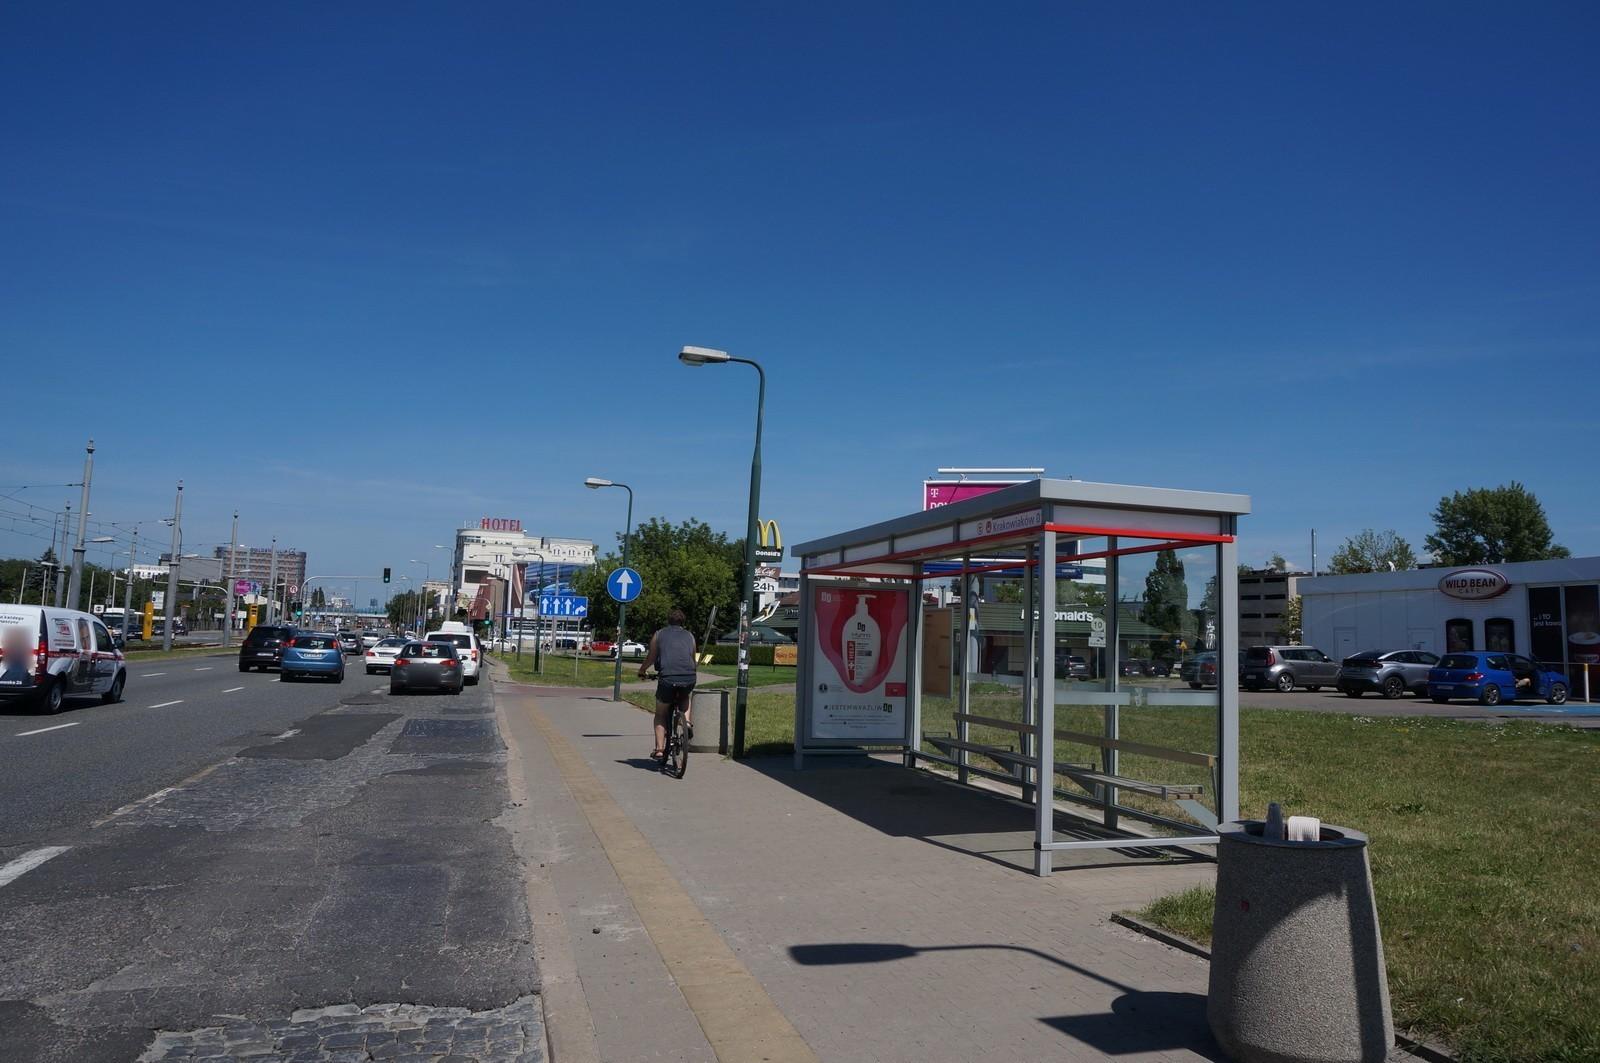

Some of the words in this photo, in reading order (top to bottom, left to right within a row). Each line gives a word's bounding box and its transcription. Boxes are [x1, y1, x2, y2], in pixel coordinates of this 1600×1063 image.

[482, 518, 523, 532] HOTEL
[755, 550, 782, 558] Donald's
[752, 582, 776, 592] 24h
[1446, 578, 1468, 589] WILD
[1470, 577, 1497, 588] BEAN
